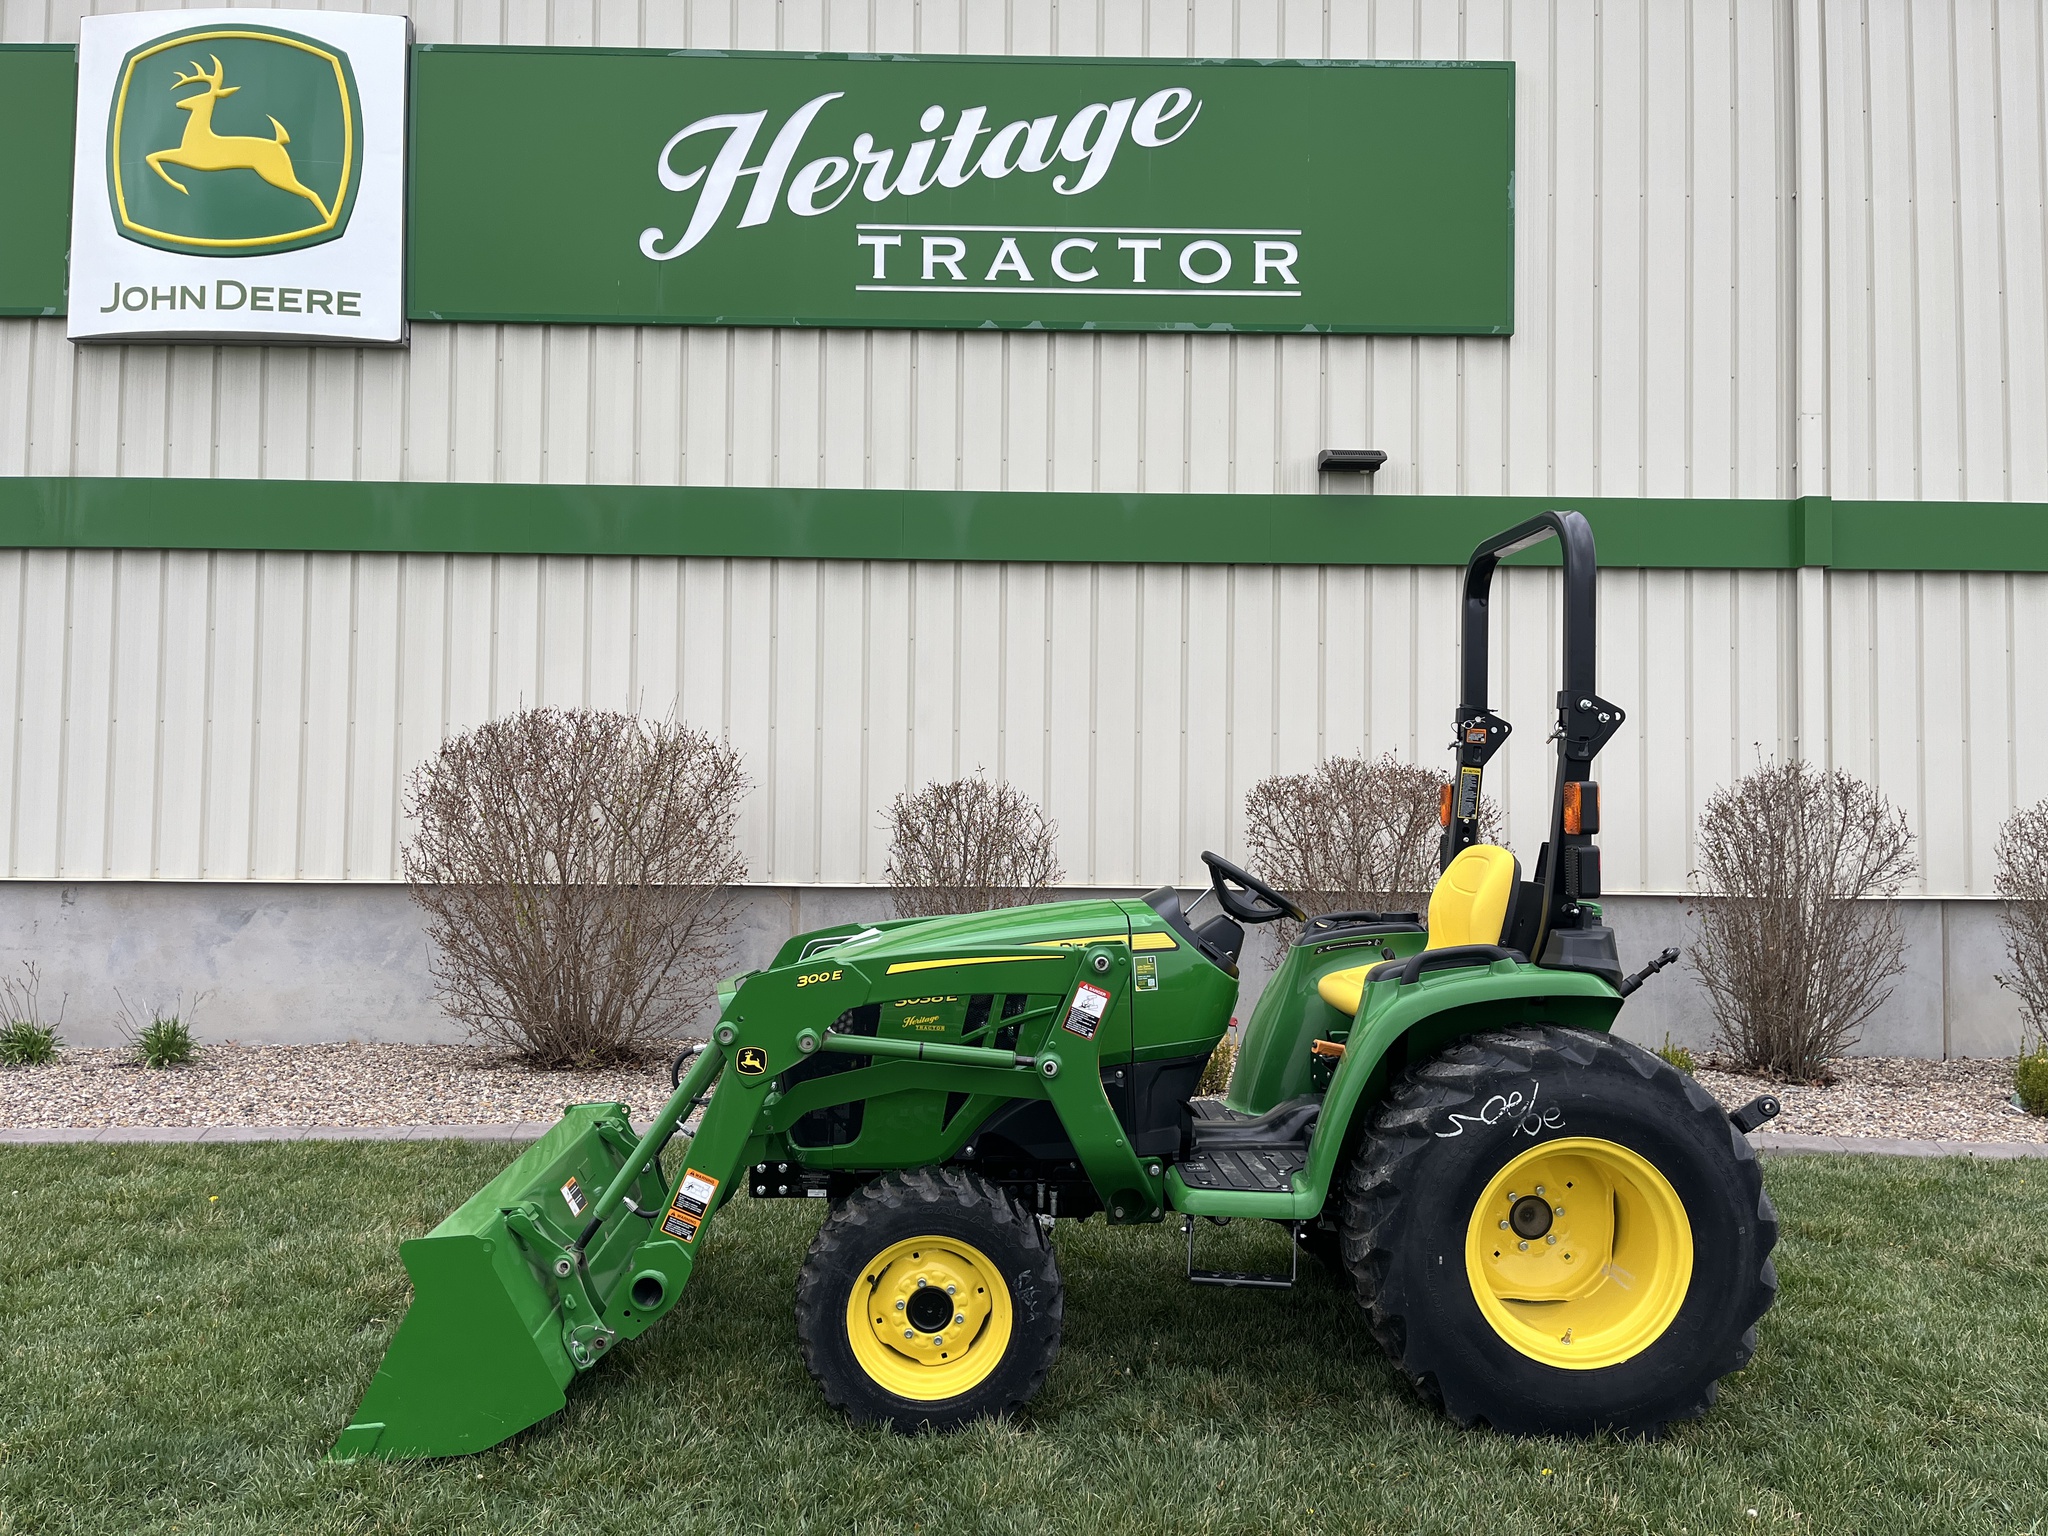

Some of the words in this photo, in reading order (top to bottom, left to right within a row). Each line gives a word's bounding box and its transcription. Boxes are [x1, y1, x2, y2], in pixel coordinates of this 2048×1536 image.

[639, 87, 1202, 262] Heritage
[857, 233, 1300, 286] TRACTOR
[215, 279, 362, 317] DEERE
[1088, 986, 1107, 996] DANGER
[902, 1015, 940, 1028] Heritage
[695, 1173, 715, 1184] WARNING
[917, 1204, 1018, 1249] GALAXY
